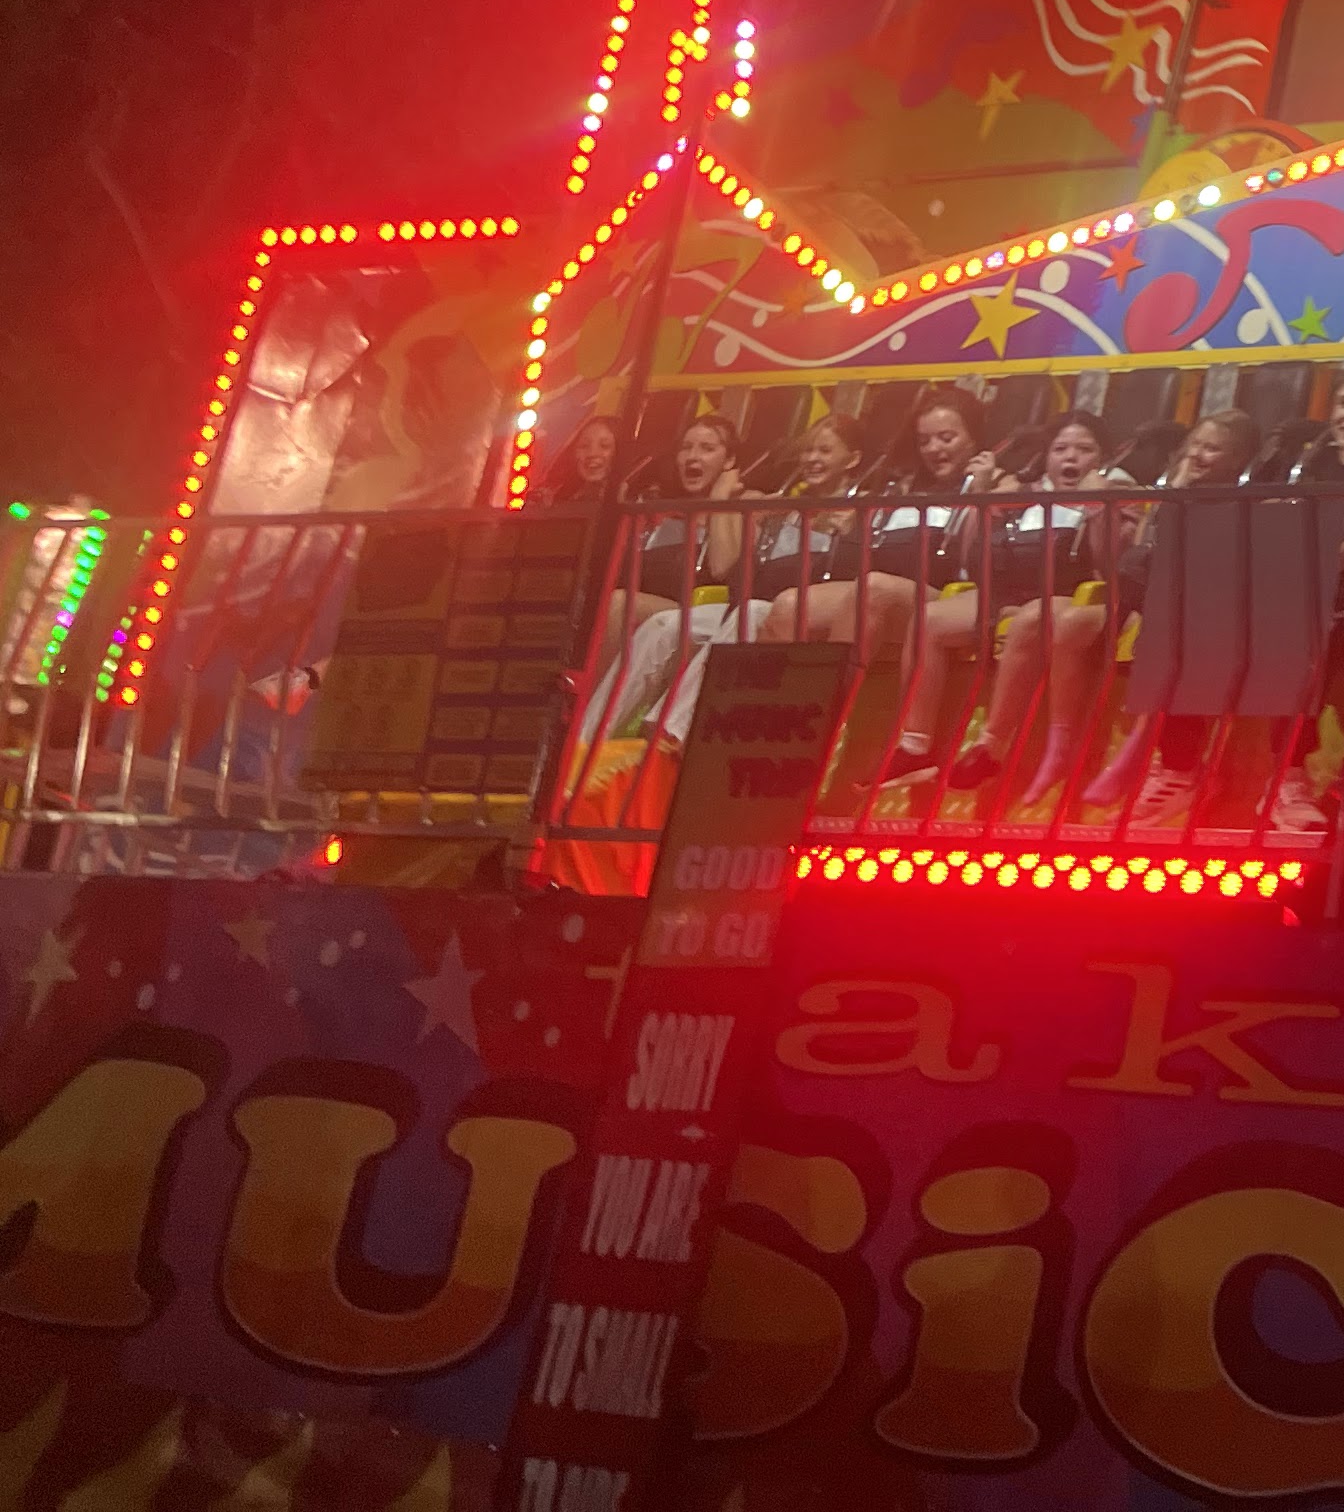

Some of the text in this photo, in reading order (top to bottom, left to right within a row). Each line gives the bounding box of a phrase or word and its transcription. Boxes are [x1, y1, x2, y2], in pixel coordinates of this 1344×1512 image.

[677, 845, 783, 891] GOOD
[655, 910, 774, 959] TO GO
[626, 1011, 735, 1112] SORRY
[581, 1154, 711, 1263] YOU ARE
[532, 1302, 585, 1408] TO
